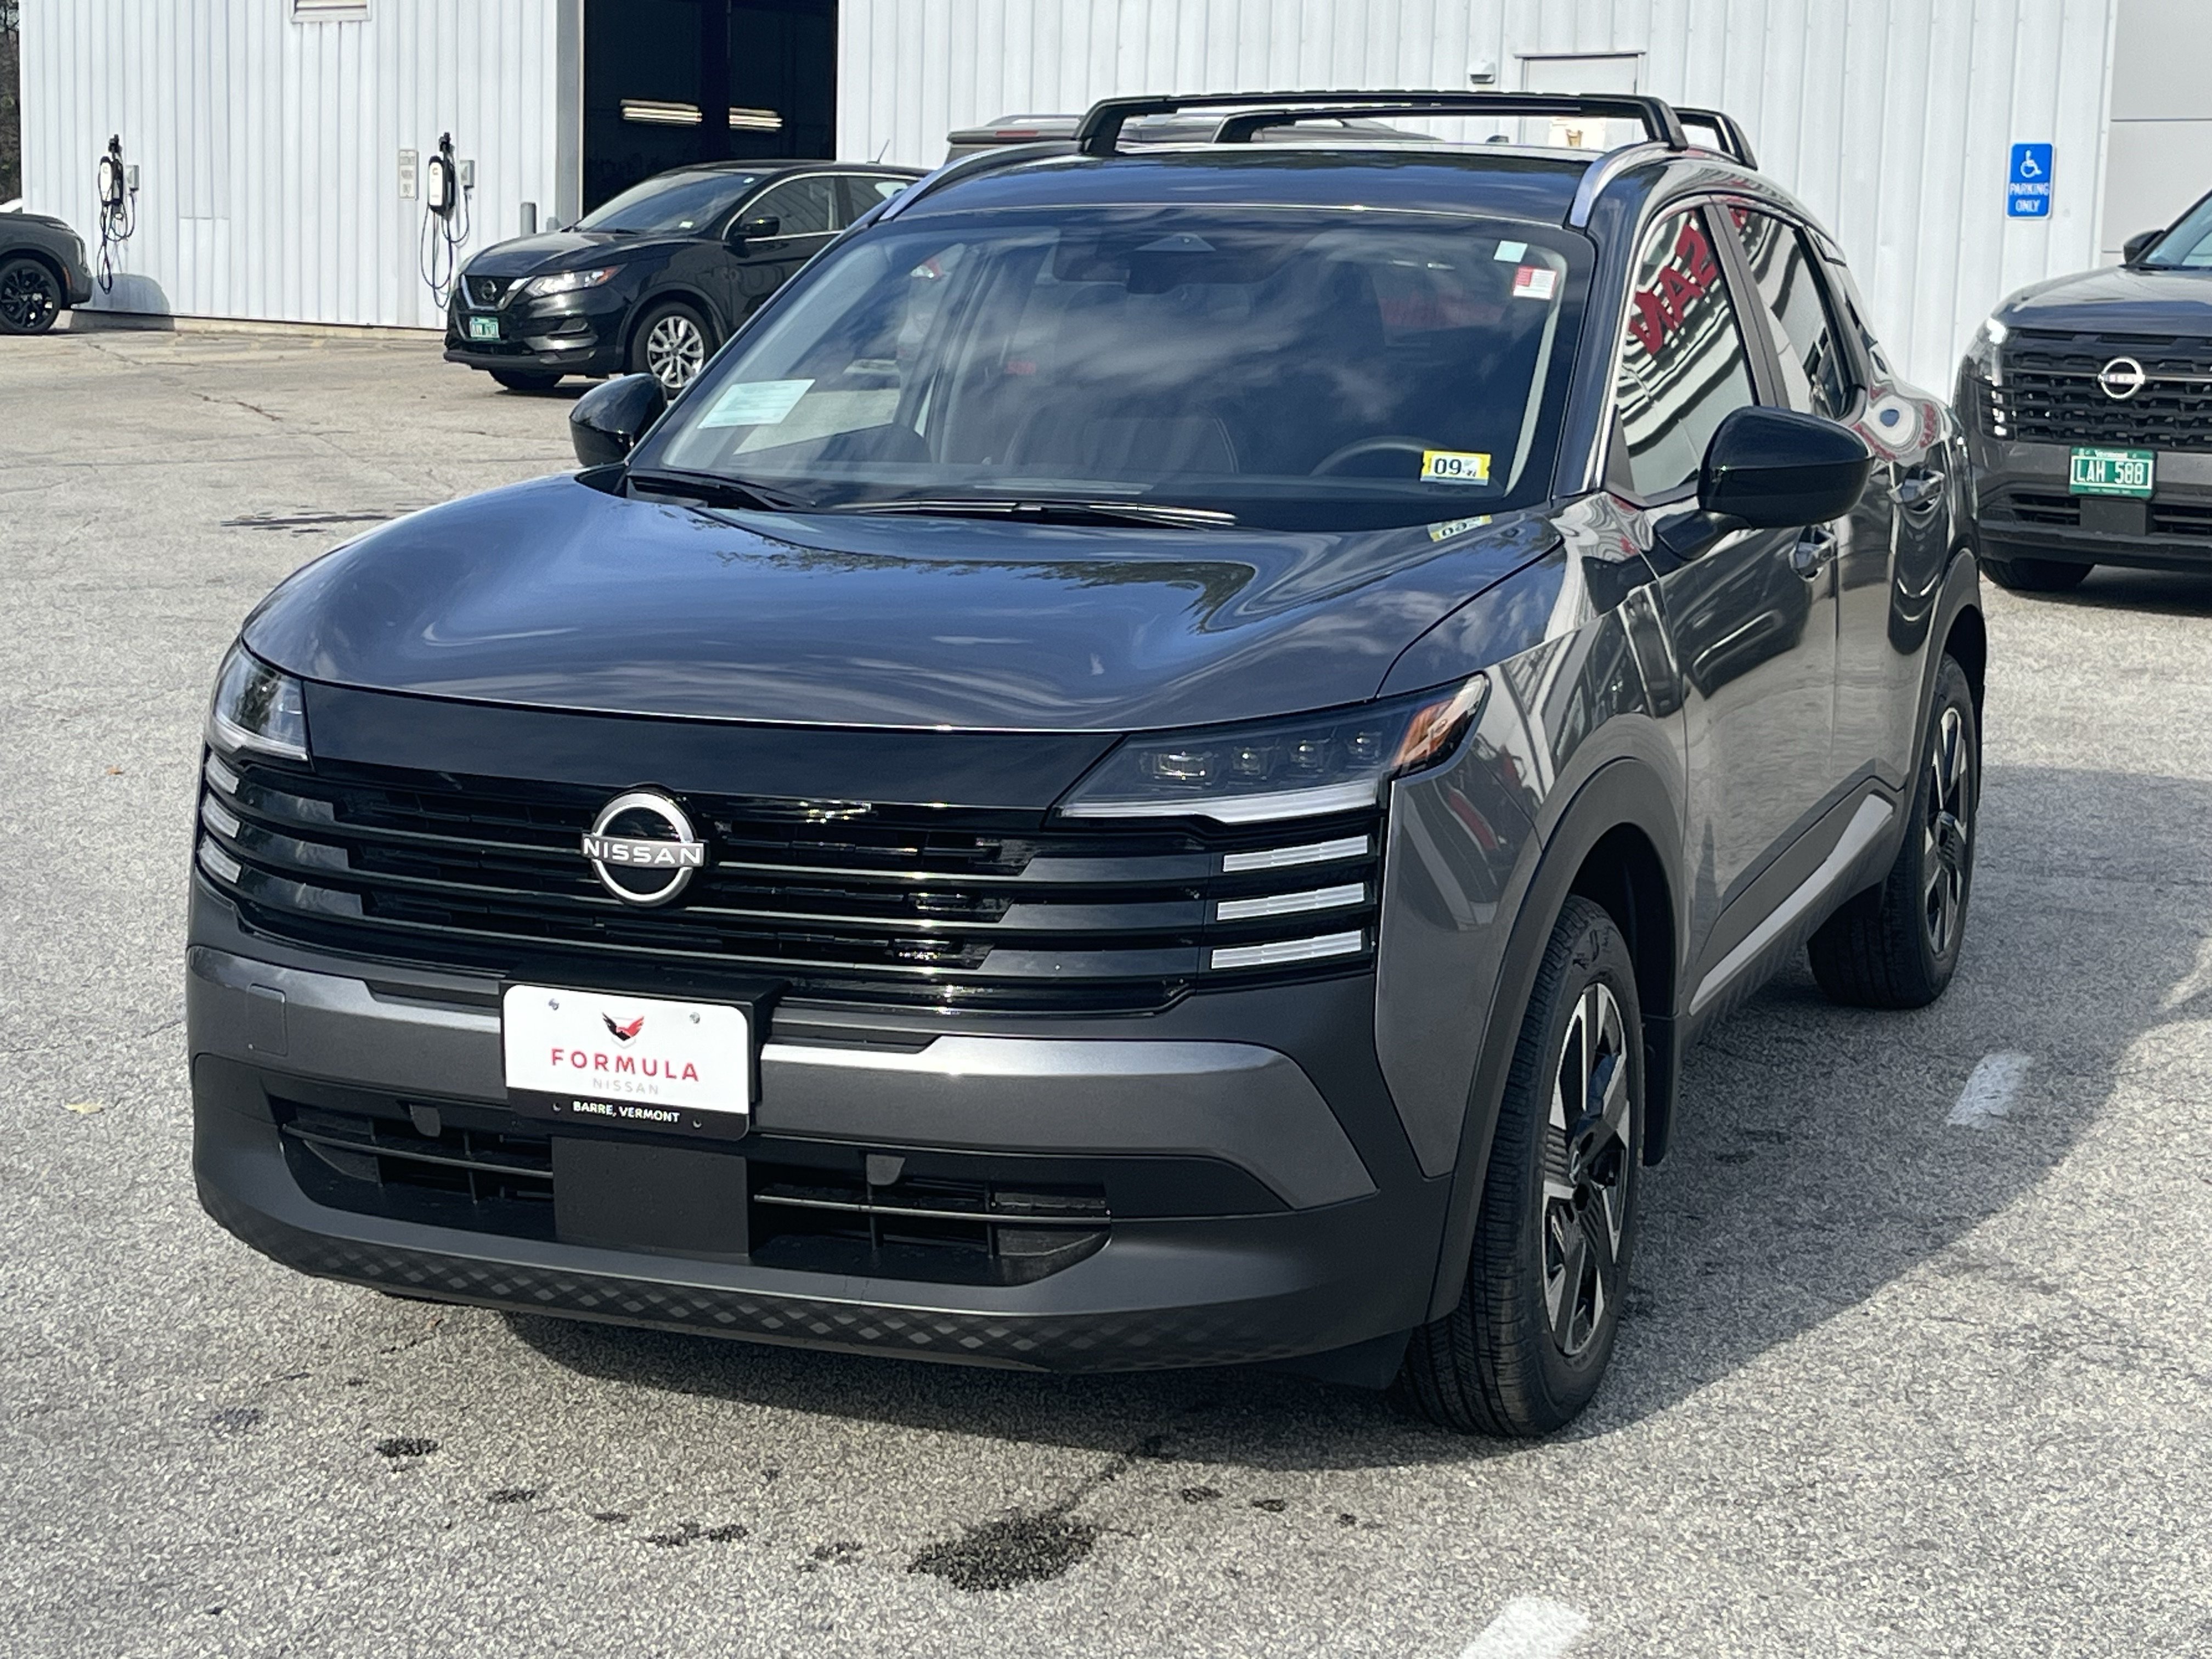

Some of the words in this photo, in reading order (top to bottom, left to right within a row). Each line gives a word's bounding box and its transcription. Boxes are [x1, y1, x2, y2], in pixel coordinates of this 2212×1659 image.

[2010, 182, 2050, 196] PARKING
[2015, 199, 2041, 213] ONLY
[1434, 458, 1462, 475] 09
[2076, 460, 2106, 482] LAH
[2114, 461, 2145, 485] 588
[583, 838, 701, 865] NISSAN
[551, 1048, 698, 1082] FORMULA
[593, 1077, 658, 1095] NISSAN
[572, 1101, 617, 1117] BARRE,
[618, 1105, 680, 1123] VERMONT
